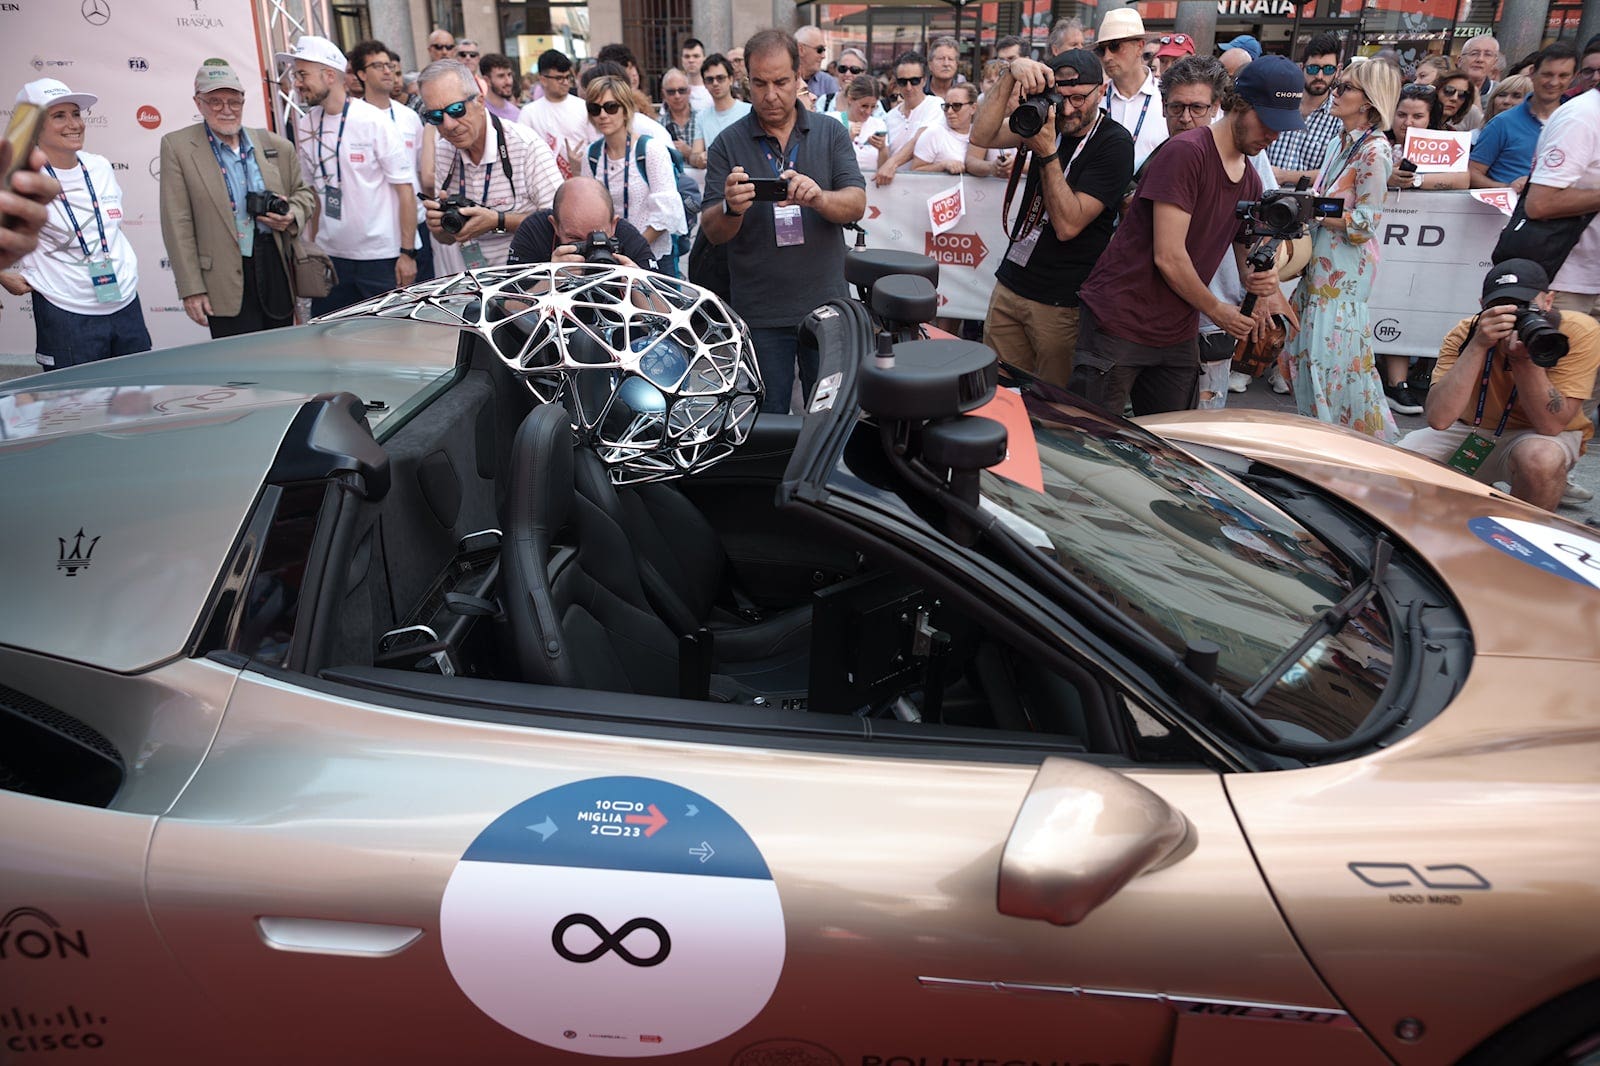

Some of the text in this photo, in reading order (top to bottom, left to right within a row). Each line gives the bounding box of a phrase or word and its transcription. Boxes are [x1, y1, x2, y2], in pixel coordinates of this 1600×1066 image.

[176, 18, 224, 28] TRASQUA
[1413, 140, 1449, 151] 1000
[1408, 153, 1450, 163] MIGLIA
[931, 236, 972, 248] 1000
[928, 251, 974, 264] MIGLIA
[596, 800, 644, 811] 1000
[577, 811, 622, 823] MIGLIA
[591, 825, 640, 837] 2023
